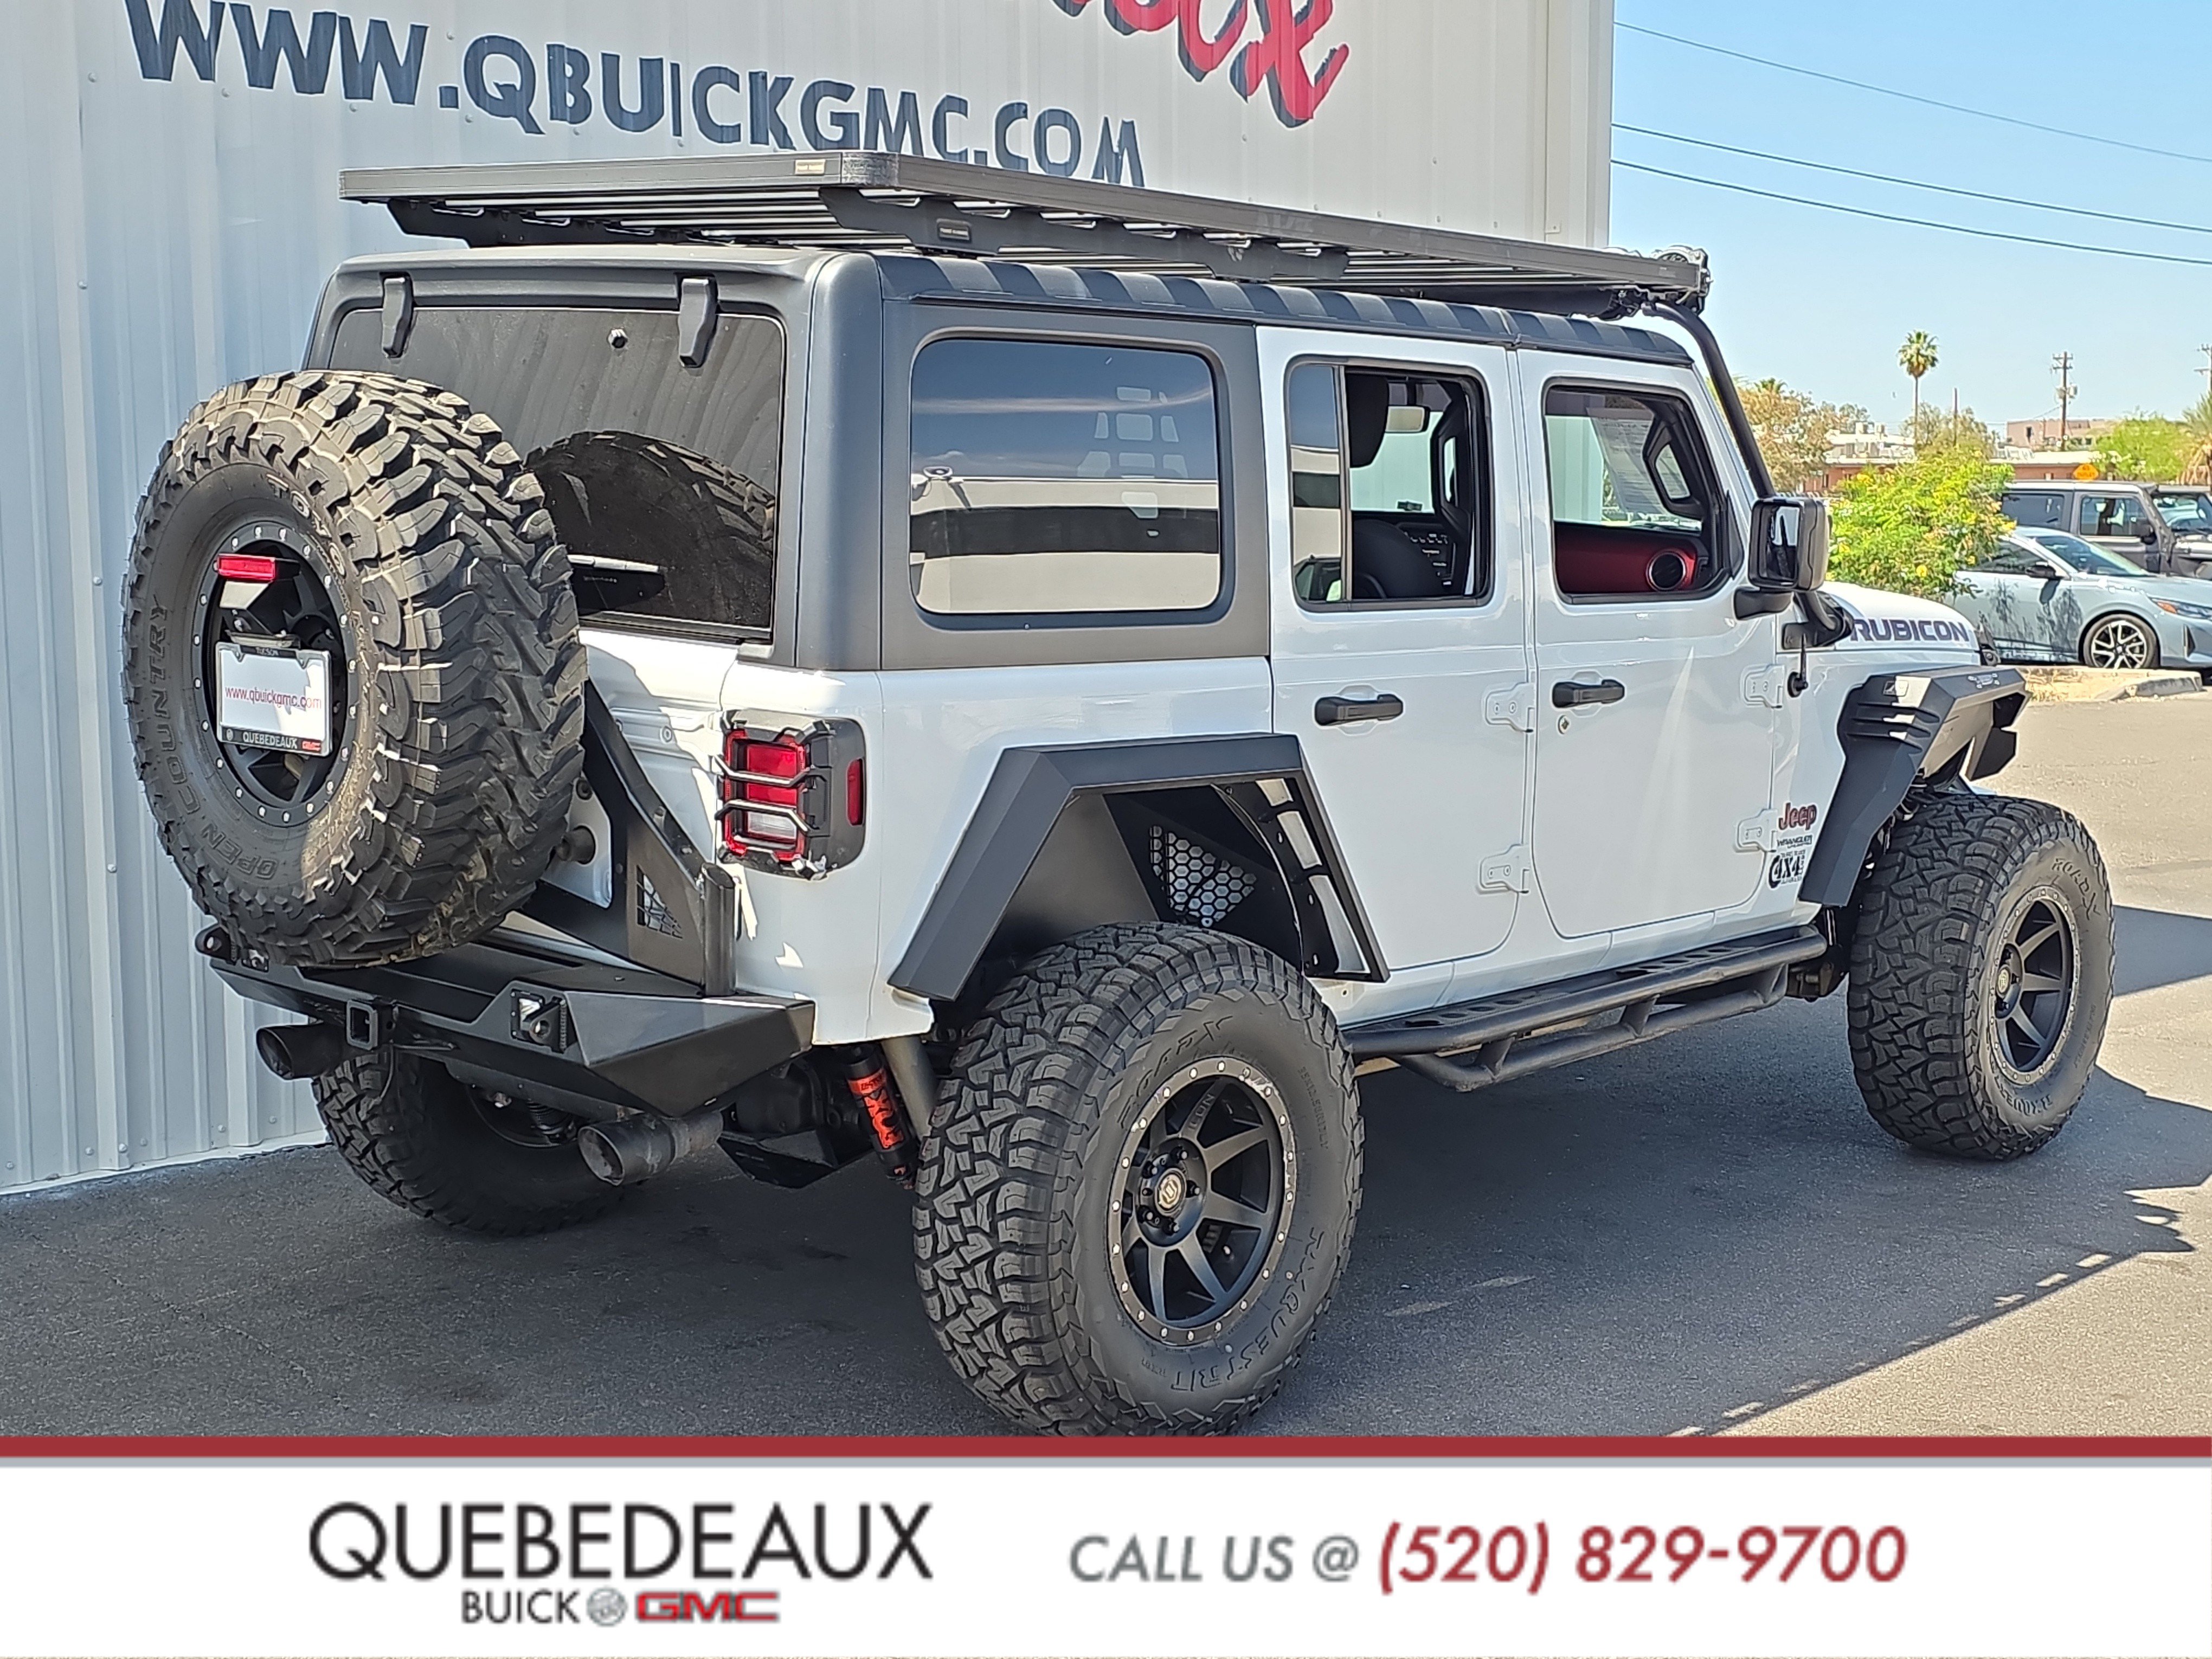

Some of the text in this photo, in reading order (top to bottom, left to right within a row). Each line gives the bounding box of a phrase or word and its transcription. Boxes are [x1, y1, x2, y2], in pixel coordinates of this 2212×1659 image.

[126, 0, 1145, 187] WWW.QBUICKGMC.COM
[266, 473, 347, 578] TOYO
[1850, 619, 1970, 642] RUBICON
[224, 686, 322, 710] www.qbuickgmc.com
[149, 594, 279, 880] OPEN COUNTRY
[242, 731, 298, 749] QUEBEDEAUX
[1778, 802, 1817, 831] Jeep
[2052, 858, 2101, 921] ROADX
